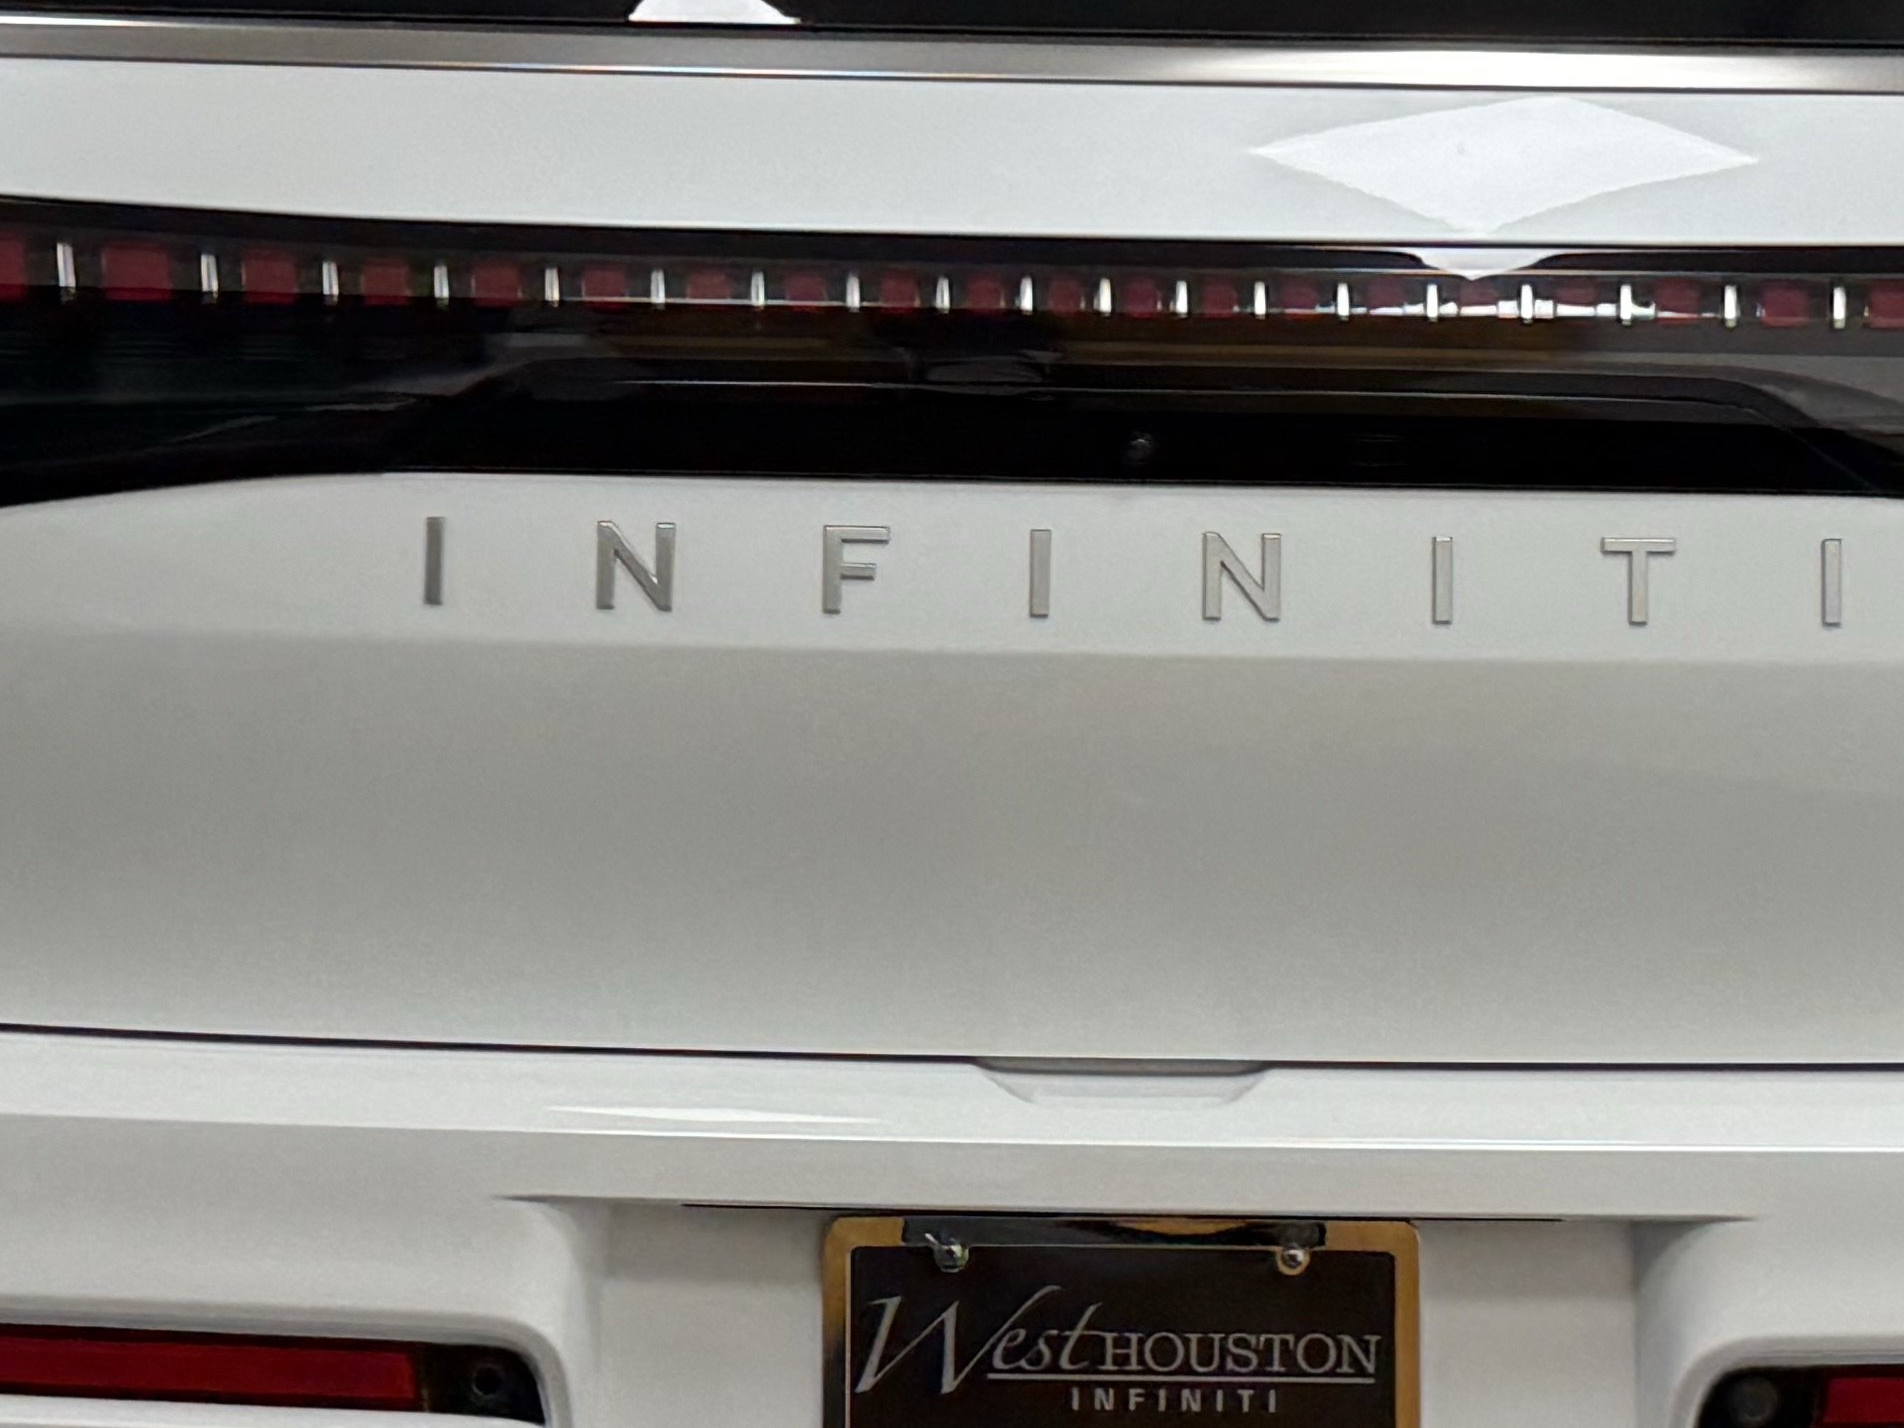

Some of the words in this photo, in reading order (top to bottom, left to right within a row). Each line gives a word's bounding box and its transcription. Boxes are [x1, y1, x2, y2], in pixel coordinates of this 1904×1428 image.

[423, 515, 1844, 628] INFINITI
[854, 1285, 1103, 1396] West
[1102, 1331, 1382, 1374] HOUSTON
[1069, 1386, 1279, 1414] INFINITI
